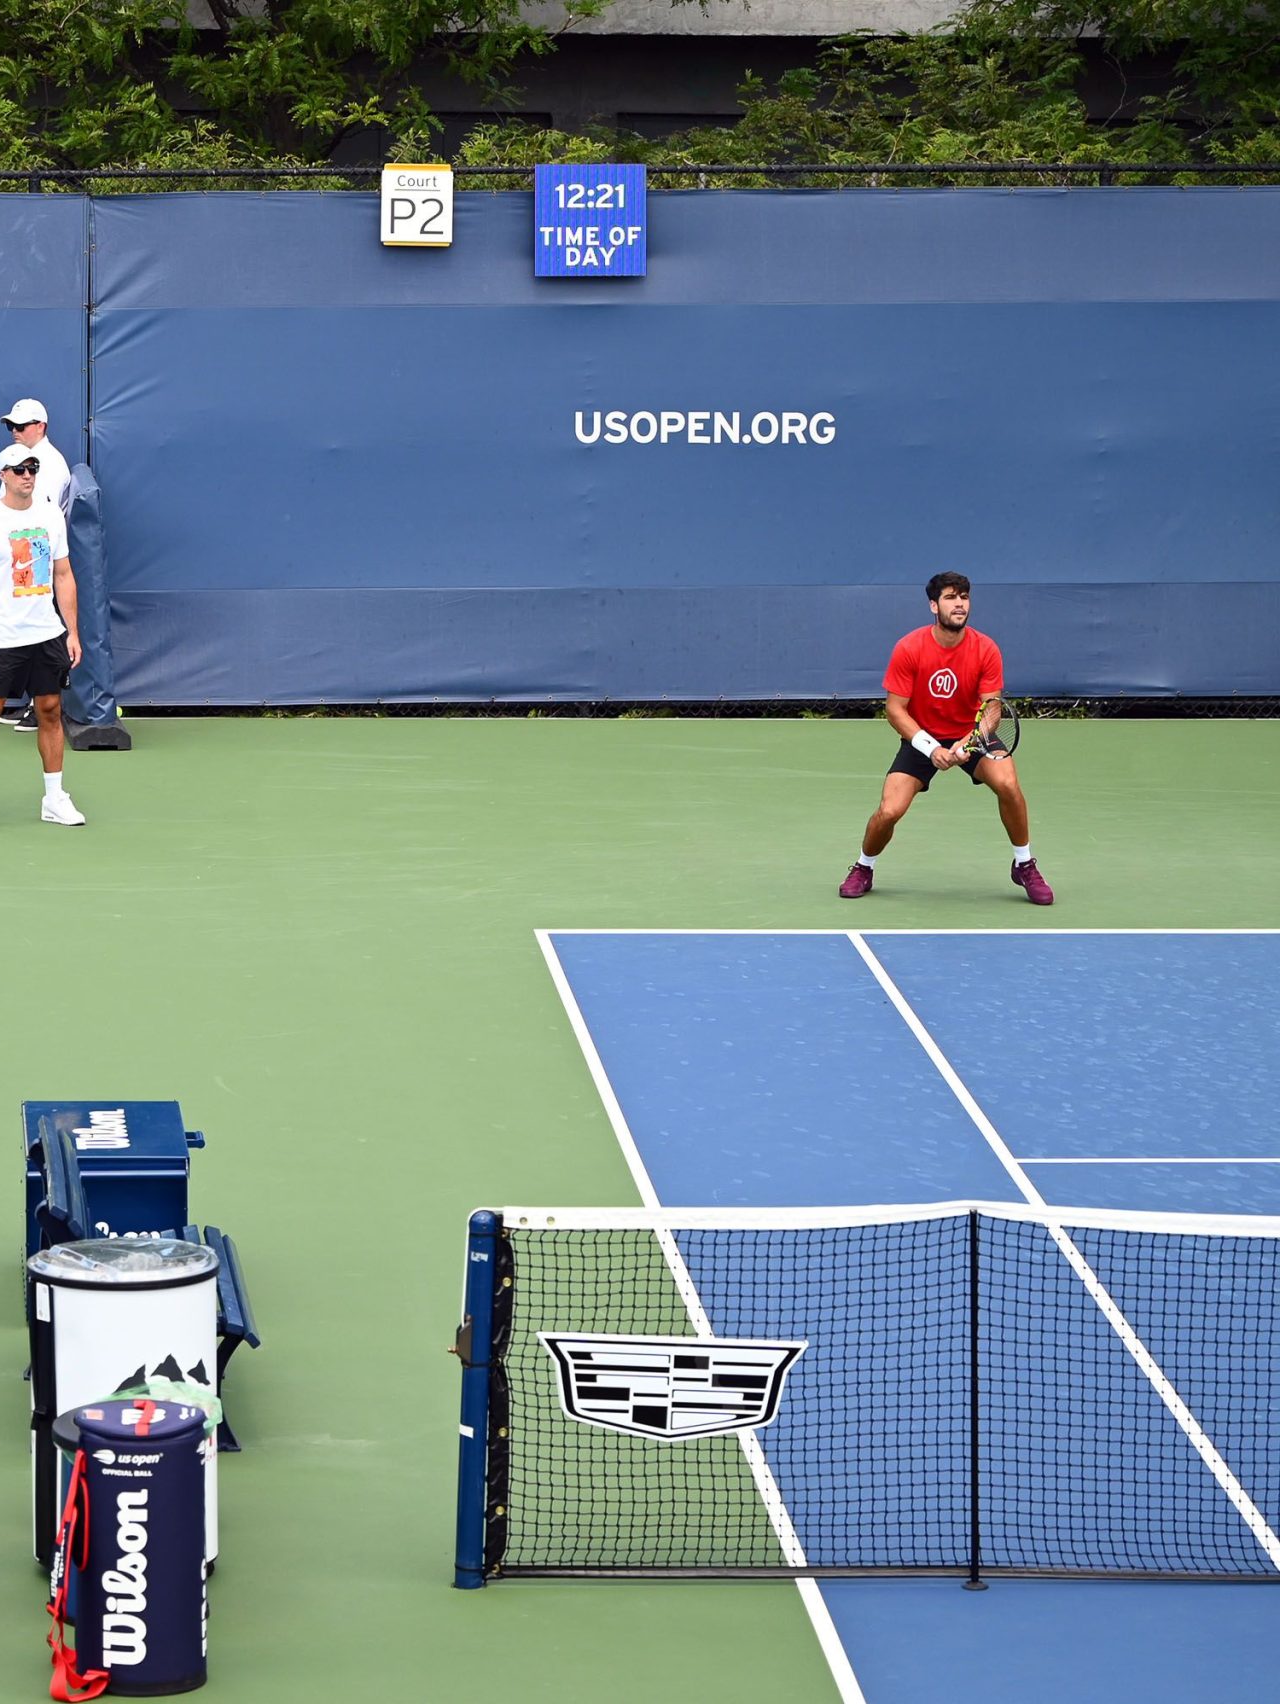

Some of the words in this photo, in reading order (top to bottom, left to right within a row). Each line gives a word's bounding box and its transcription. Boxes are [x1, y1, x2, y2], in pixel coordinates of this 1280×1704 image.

[397, 174, 437, 188] Court
[554, 183, 625, 209] 12:21
[389, 198, 444, 235] P2
[539, 226, 600, 247] TIME
[608, 226, 642, 246] OF
[565, 247, 616, 267] DAY
[574, 410, 836, 445] USOPEN.ORG
[936, 674, 951, 693] 90
[131, 1454, 160, 1467] open
[102, 1468, 133, 1477] OFFICIAL
[101, 1488, 148, 1668] Wilson
